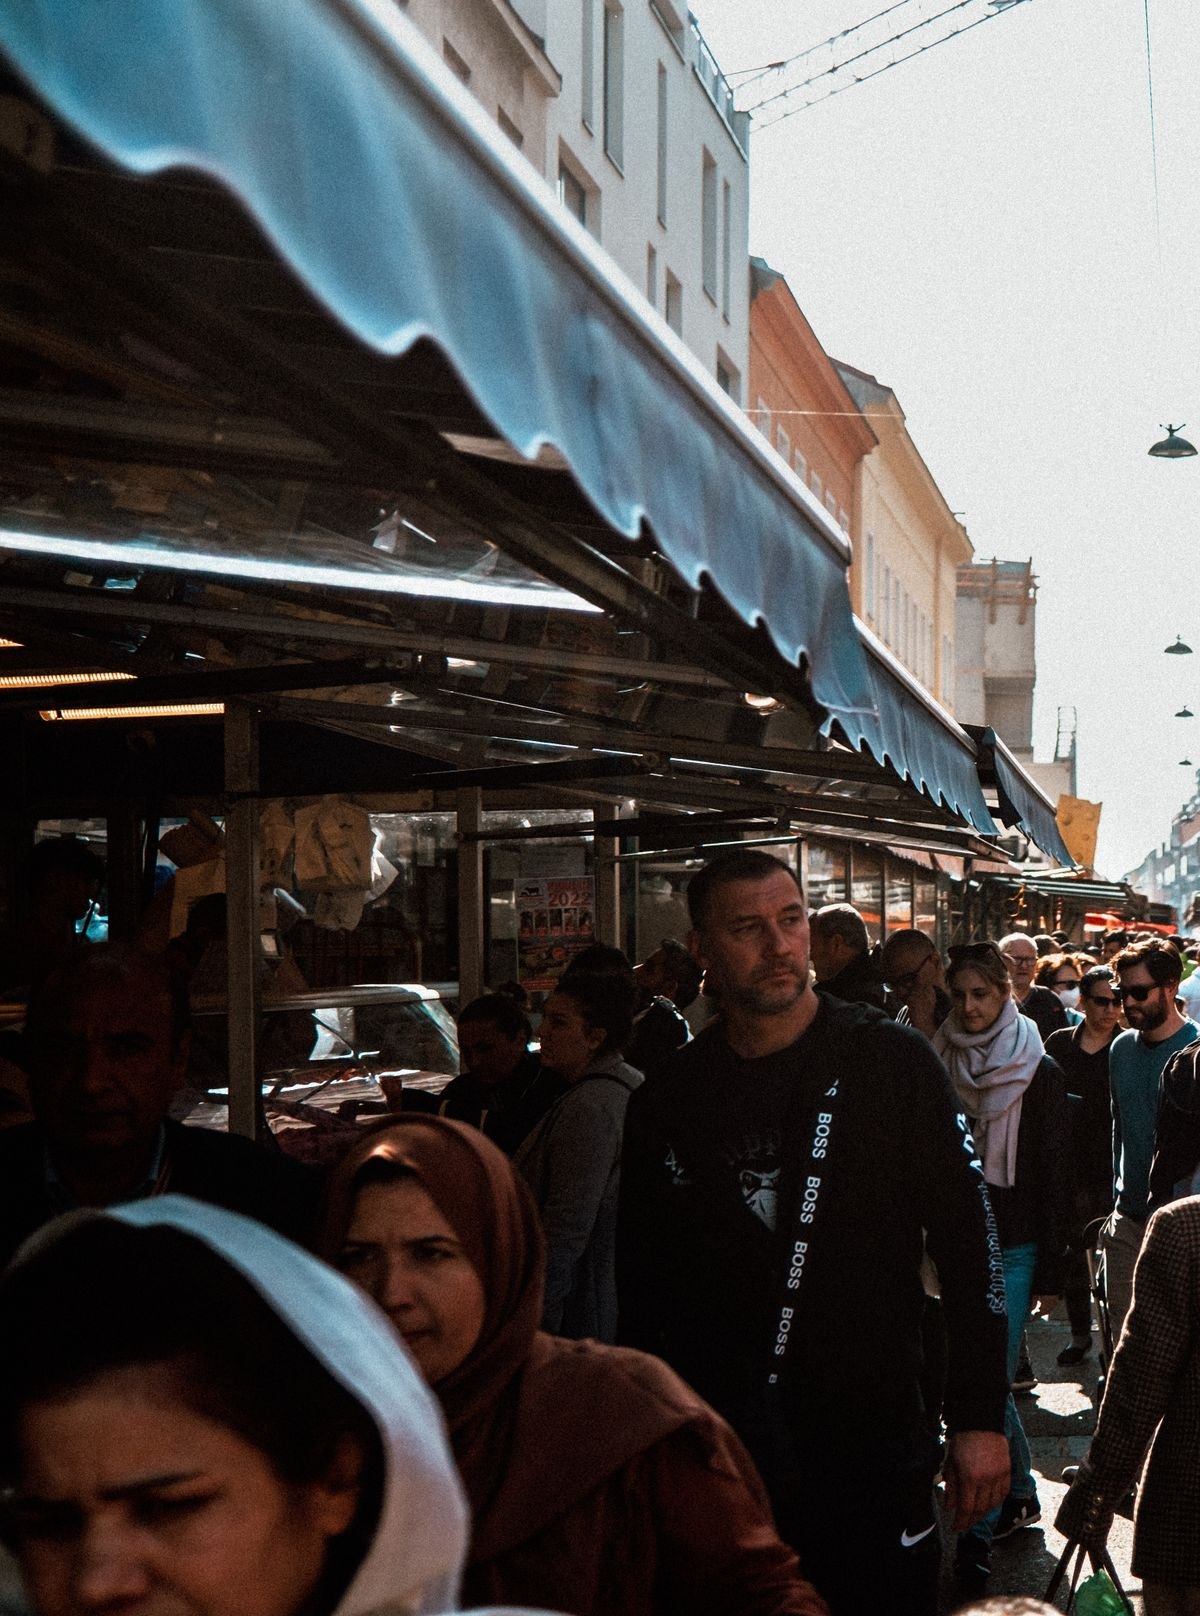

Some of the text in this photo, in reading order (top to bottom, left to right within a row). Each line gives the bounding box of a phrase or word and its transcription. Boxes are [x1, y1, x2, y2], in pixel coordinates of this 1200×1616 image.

[549, 892, 589, 907] 2022
[811, 1112, 833, 1160] BOSS
[800, 1175, 822, 1224] BOSS
[787, 1240, 808, 1290] BOSS
[774, 1306, 794, 1356] BOSS
